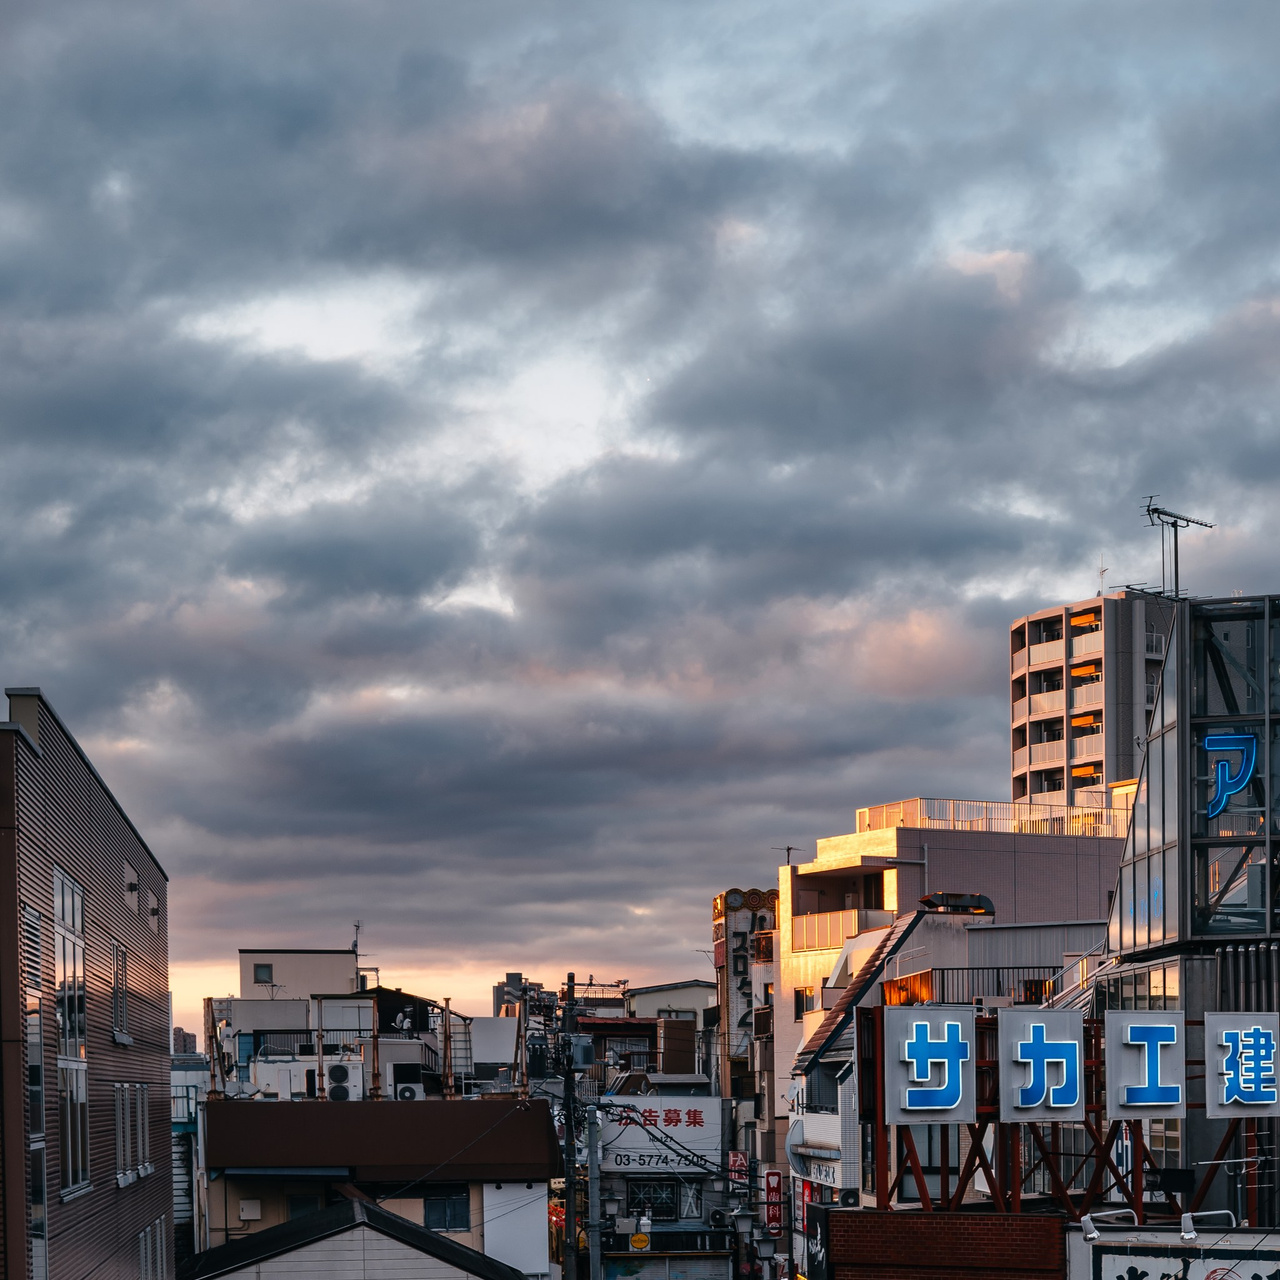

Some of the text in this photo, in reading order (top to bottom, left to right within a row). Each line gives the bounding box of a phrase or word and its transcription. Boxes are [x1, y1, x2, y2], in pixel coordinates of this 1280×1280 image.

[618, 1109, 704, 1127] 広告募集
[615, 1154, 707, 1166] 03-5774-7505
